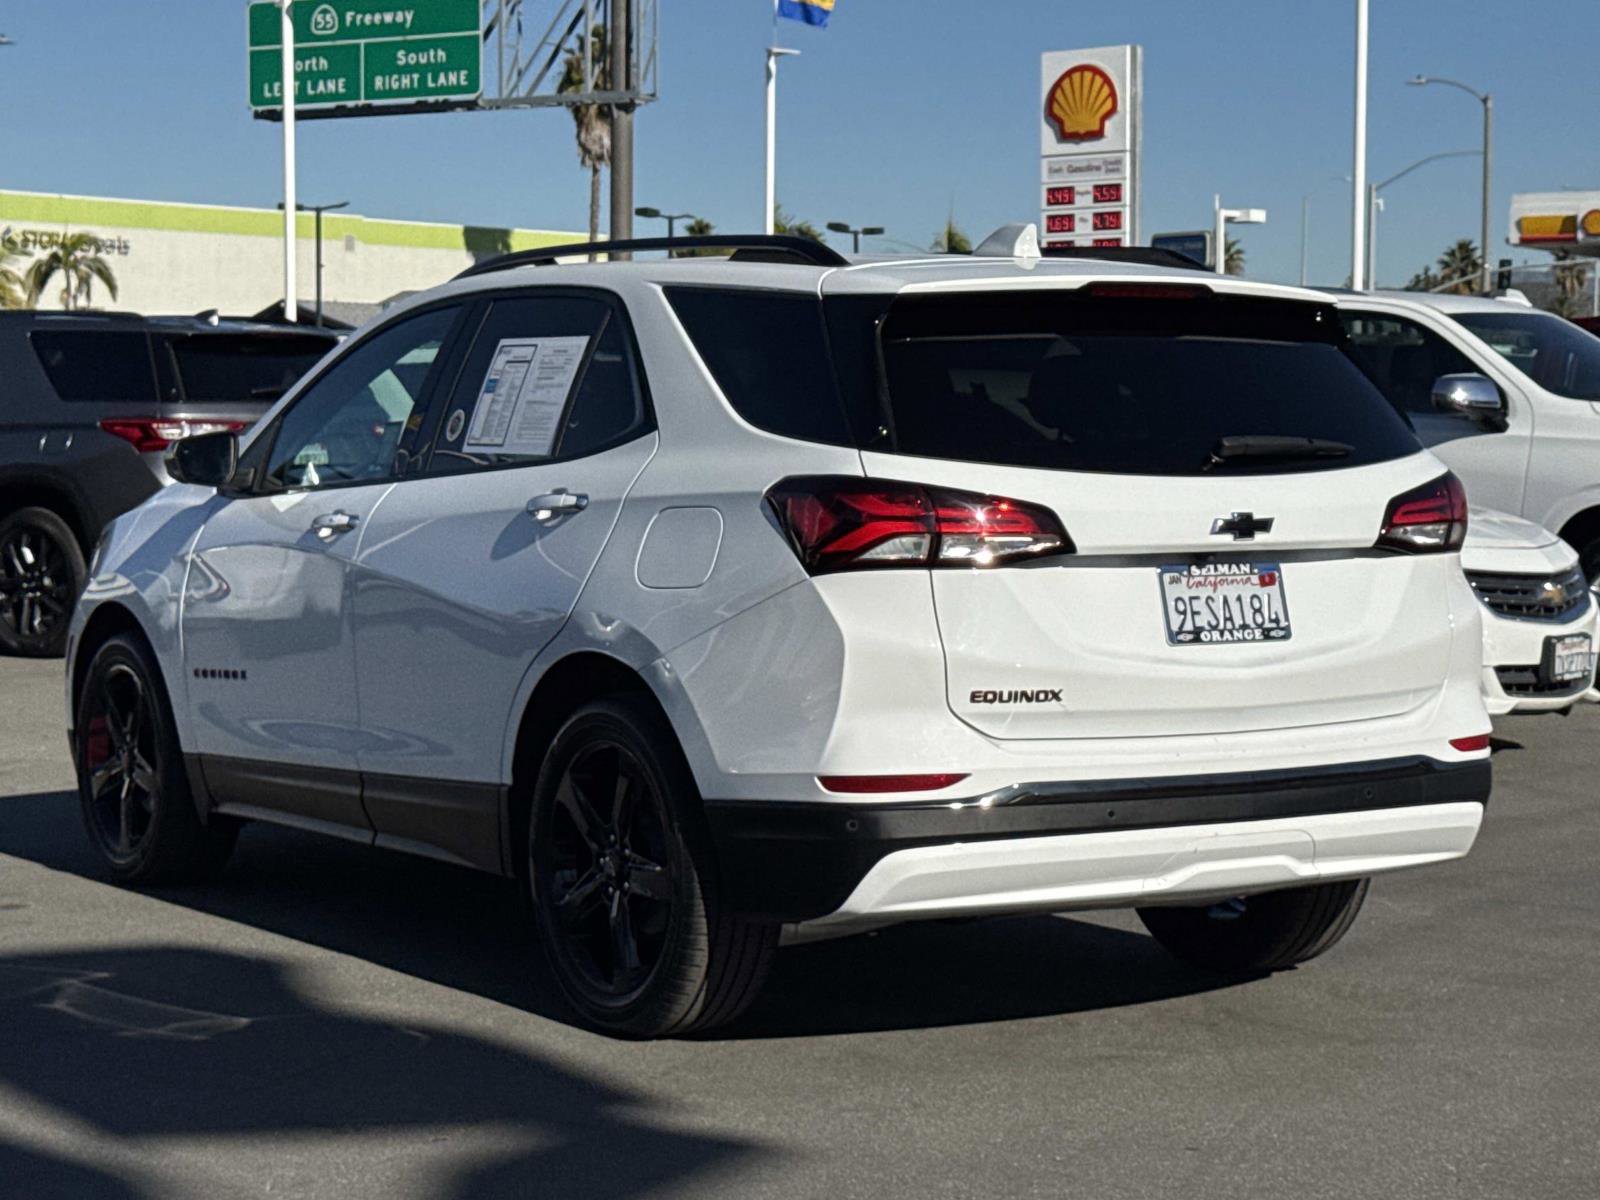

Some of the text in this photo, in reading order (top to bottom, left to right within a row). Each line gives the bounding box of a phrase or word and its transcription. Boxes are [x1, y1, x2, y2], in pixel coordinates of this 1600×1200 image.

[315, 9, 415, 30] 55 Freeway
[294, 55, 329, 72] orth
[396, 48, 447, 66] South
[263, 78, 347, 98] LET LANE
[374, 70, 469, 91] RIGHT LANE
[1185, 575, 1259, 593] California
[1174, 593, 1281, 631] 9ESA184
[1200, 629, 1265, 642] ORANGE
[970, 688, 1063, 704] EQUINOX
